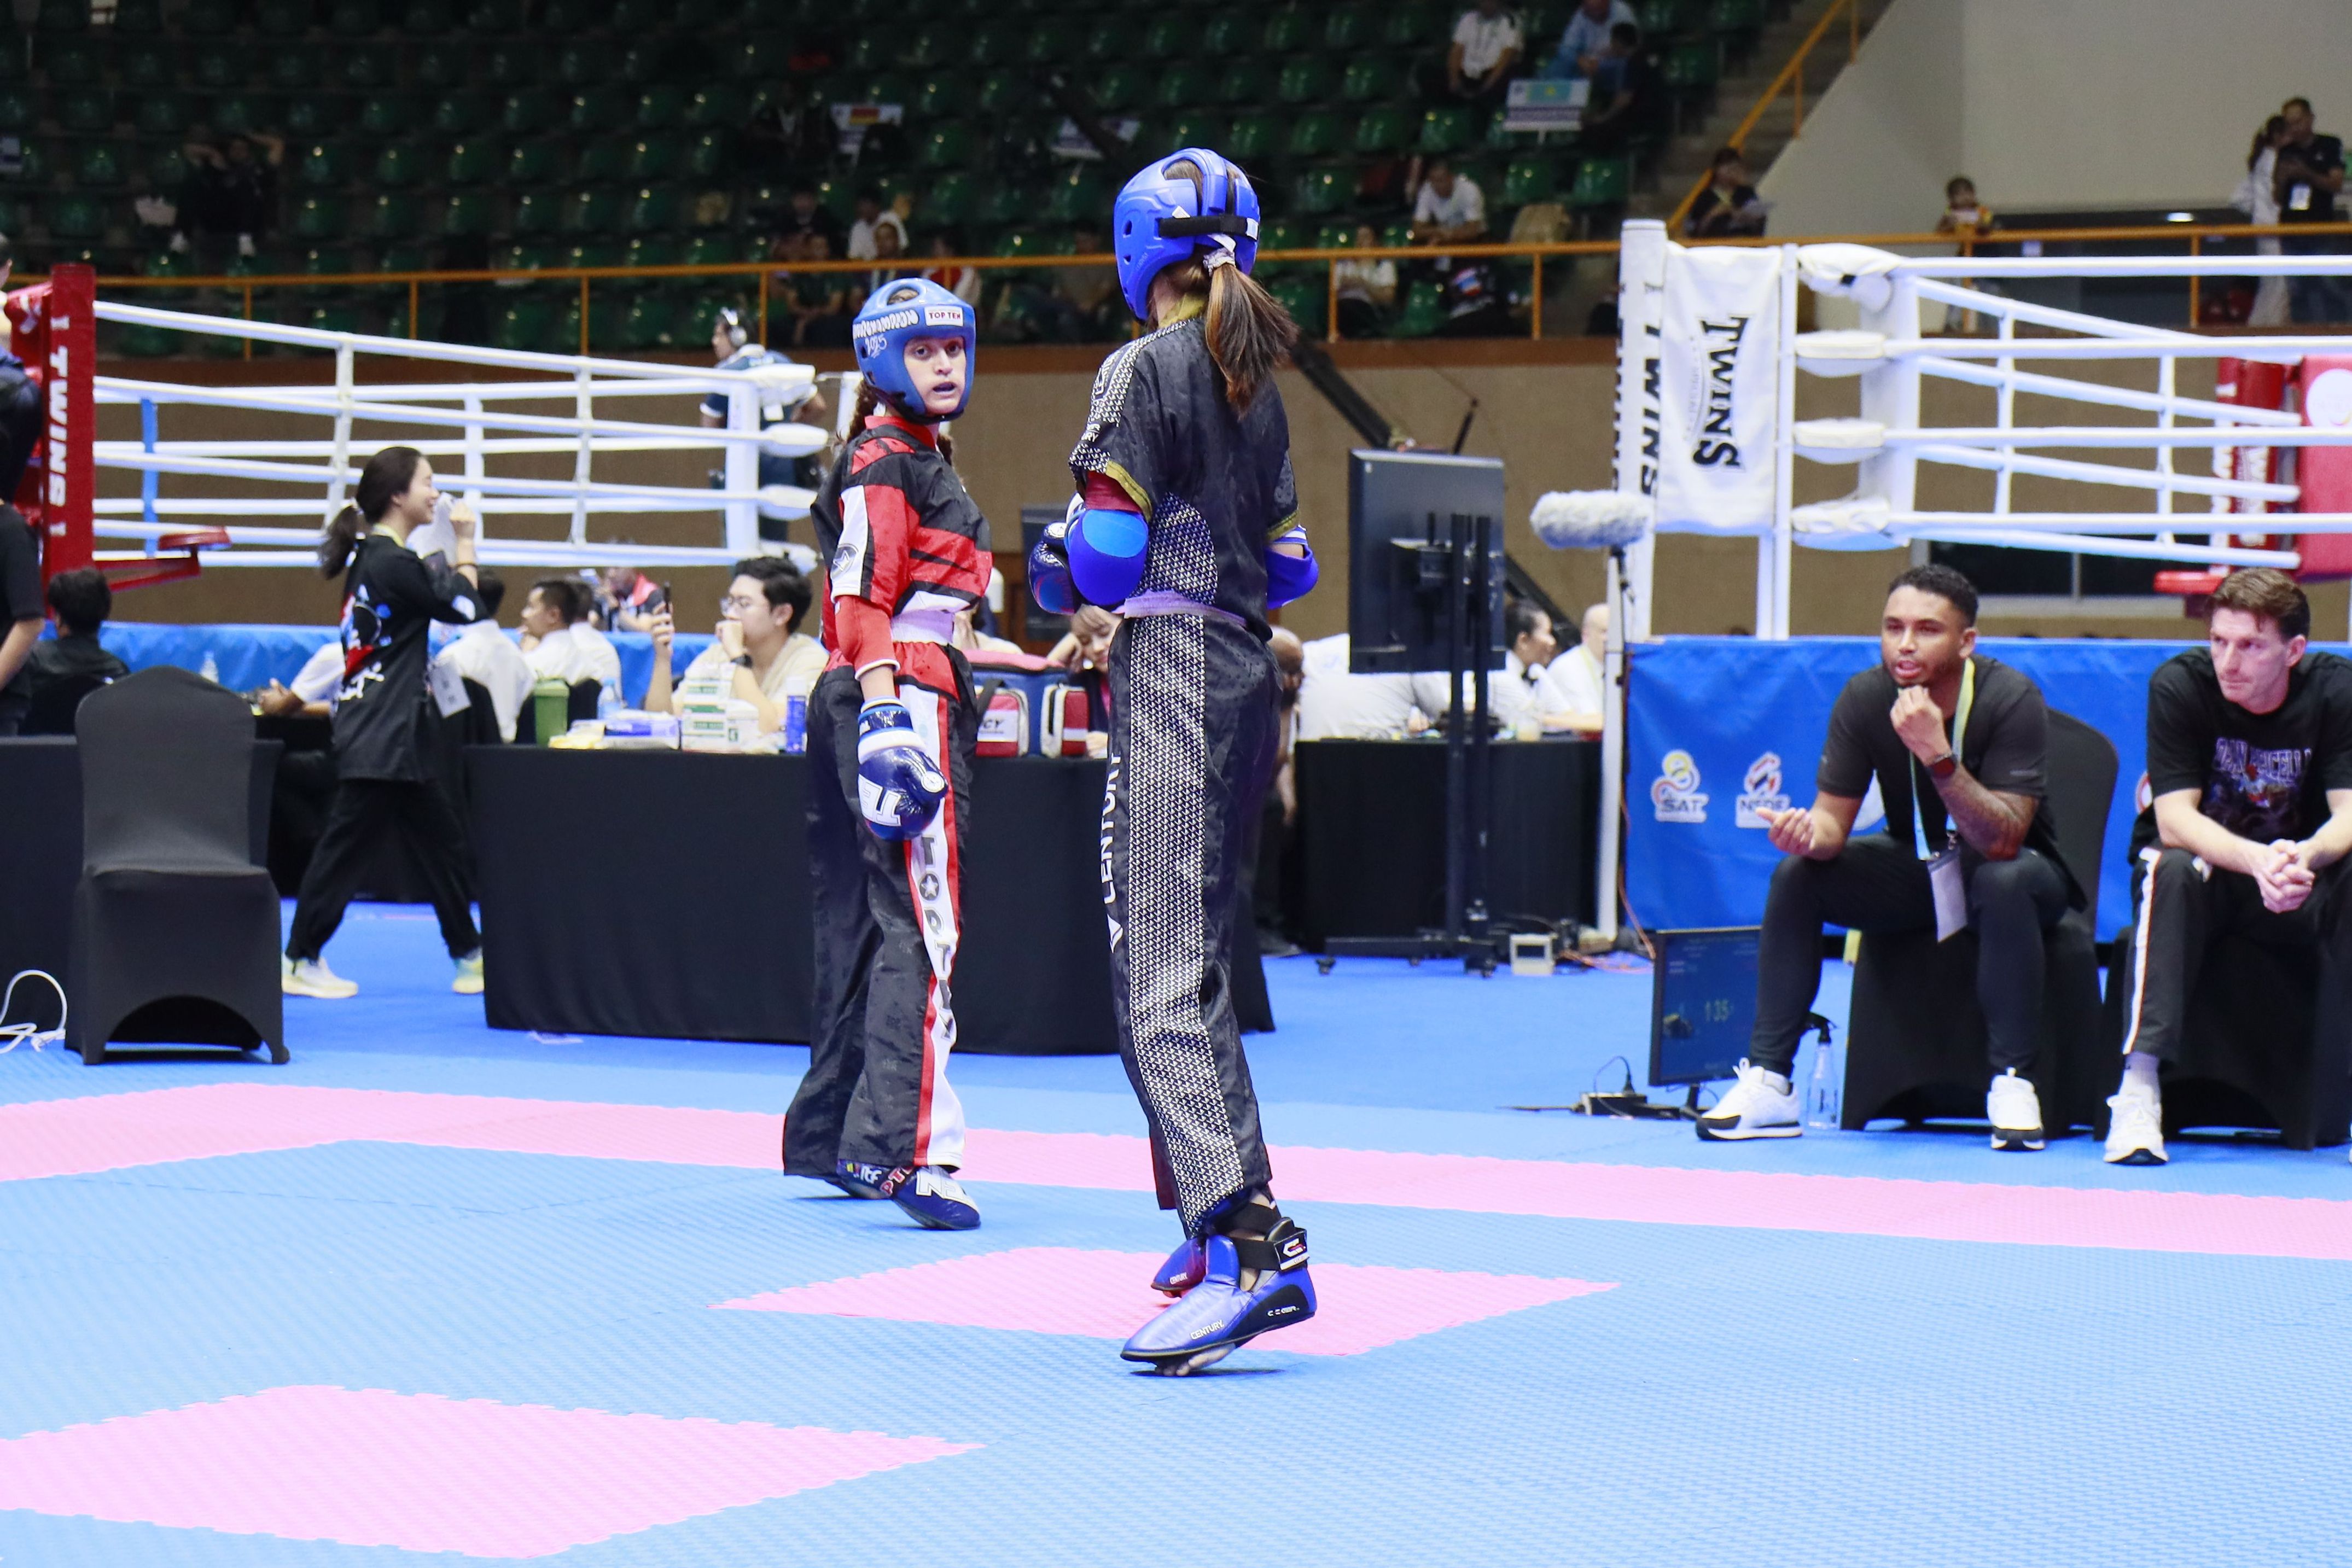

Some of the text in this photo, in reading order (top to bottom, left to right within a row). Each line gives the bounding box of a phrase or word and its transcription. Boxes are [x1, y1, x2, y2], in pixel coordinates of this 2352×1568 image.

[929, 312, 961, 320] TOP TEN
[49, 346, 68, 507] TWINS
[1692, 316, 1748, 469] TWINS
[1190, 1319, 1224, 1340] CENTURY
